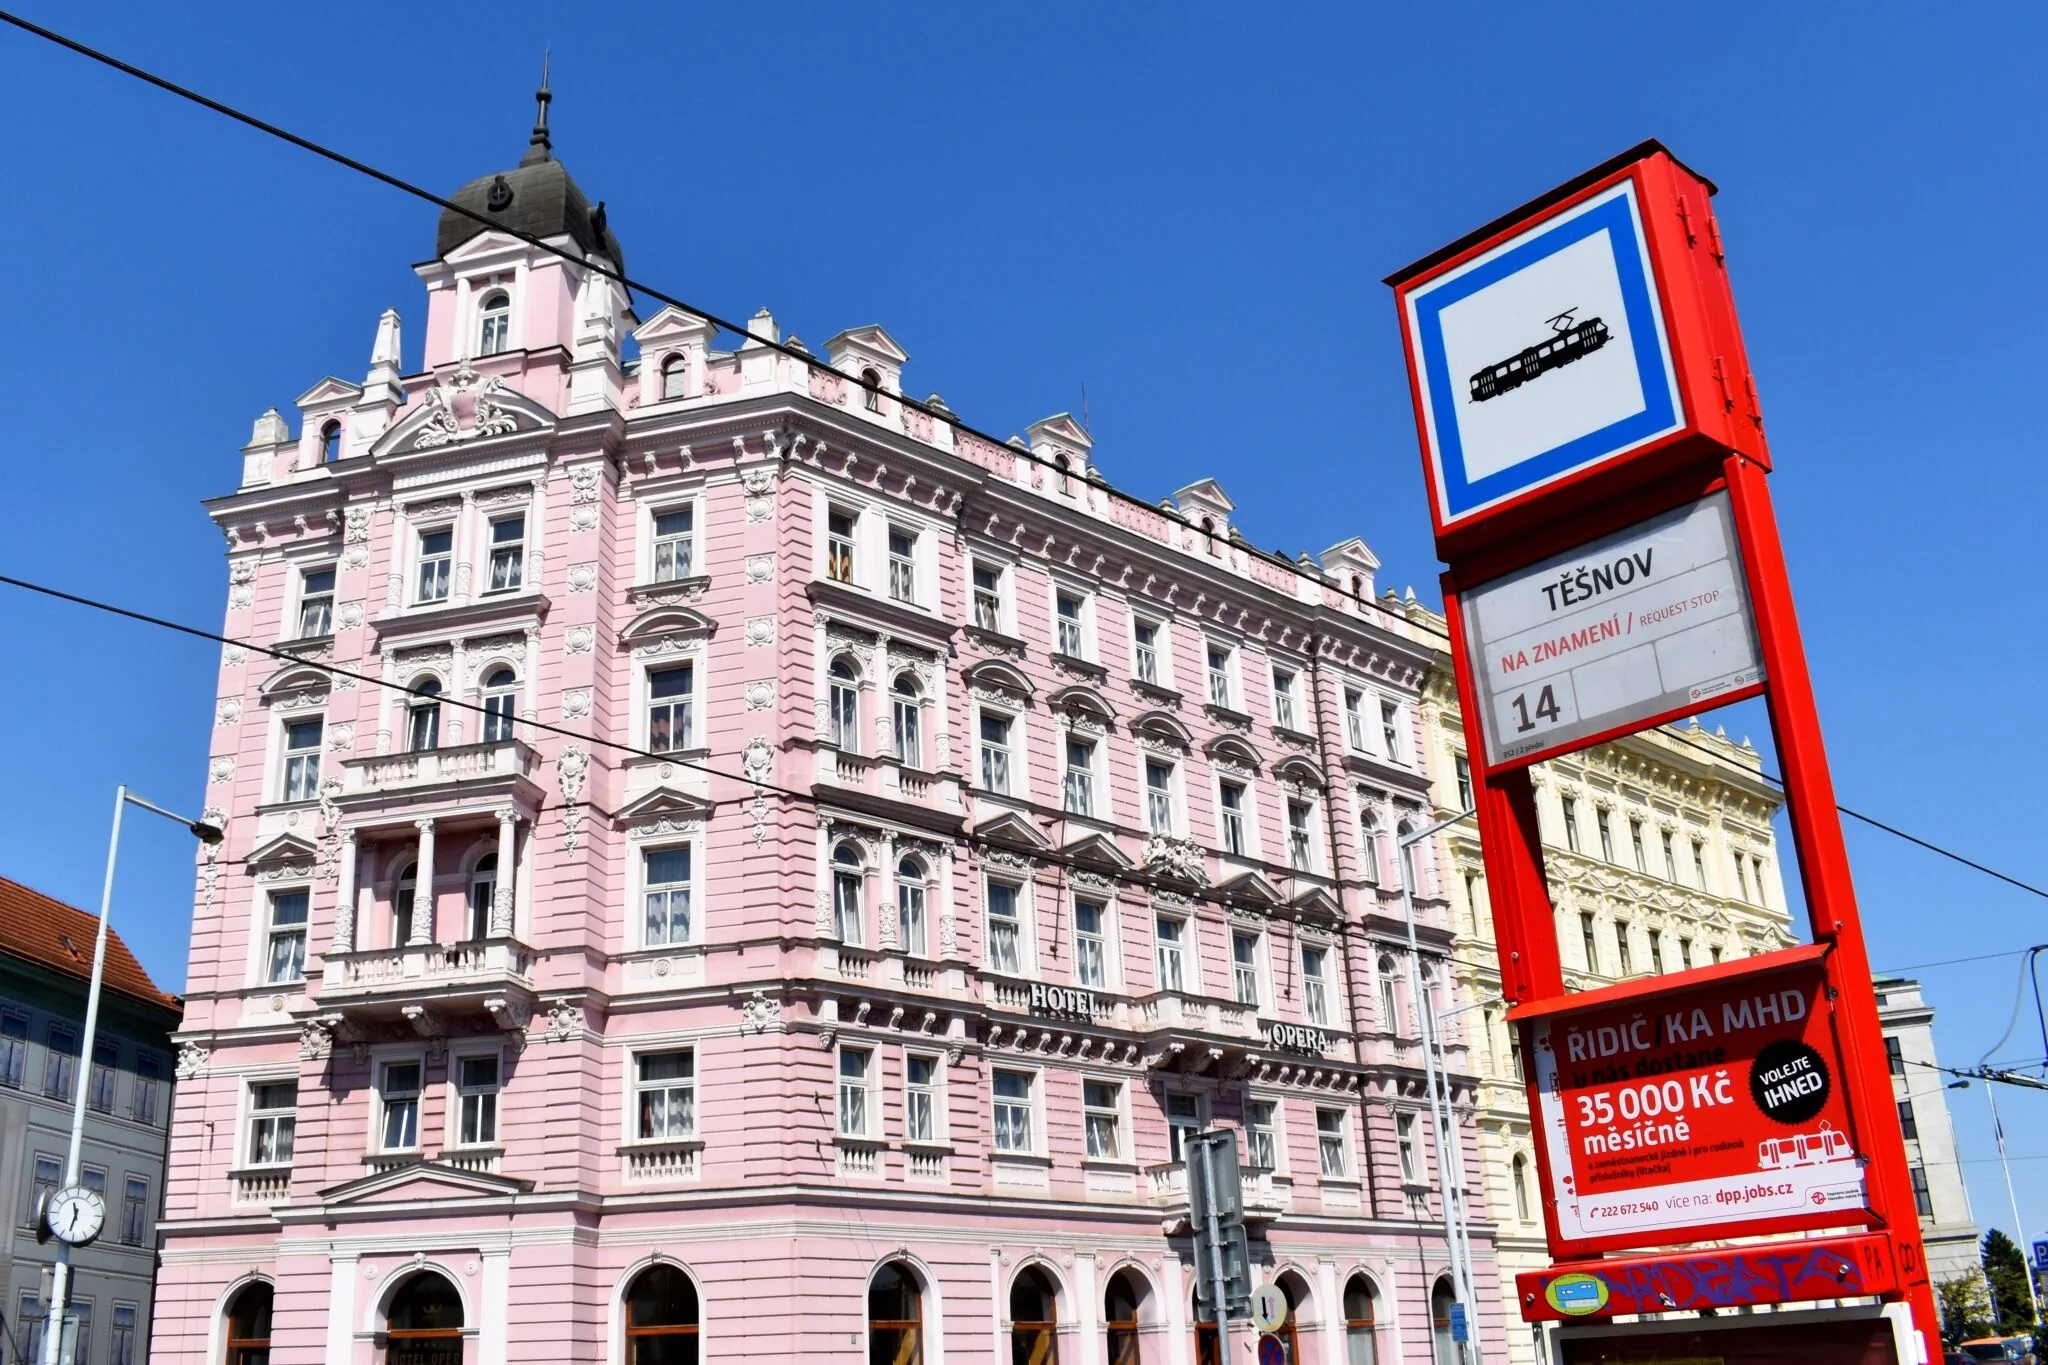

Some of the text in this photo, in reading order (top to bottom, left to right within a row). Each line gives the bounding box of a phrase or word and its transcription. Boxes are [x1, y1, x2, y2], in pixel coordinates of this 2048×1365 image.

[1542, 548, 1652, 611] TĚŠNOV
[1502, 653, 1529, 673] NA
[1532, 613, 1620, 664] ZNAMENÍ
[1640, 602, 1688, 626] REQUEST
[1691, 590, 1720, 609] STOP
[1512, 684, 1561, 733] 14
[1031, 984, 1100, 1016] HOTEL
[1273, 1023, 1327, 1052] OPERA
[1567, 989, 1806, 1063] ŘIDIČ/KA MHD
[1574, 1046, 1726, 1088] u nás dostane
[1759, 1056, 1811, 1085] VOLEJTE
[1577, 1069, 1734, 1127] 35 000 Kč
[1764, 1072, 1823, 1109] IHNED
[1583, 1115, 1690, 1155] měsíčně
[1693, 1145, 1709, 1157] pro
[1601, 1183, 1794, 1218] 222 672 540 více na: dpp.jobs.cz
[2037, 1245, 2047, 1263] P
